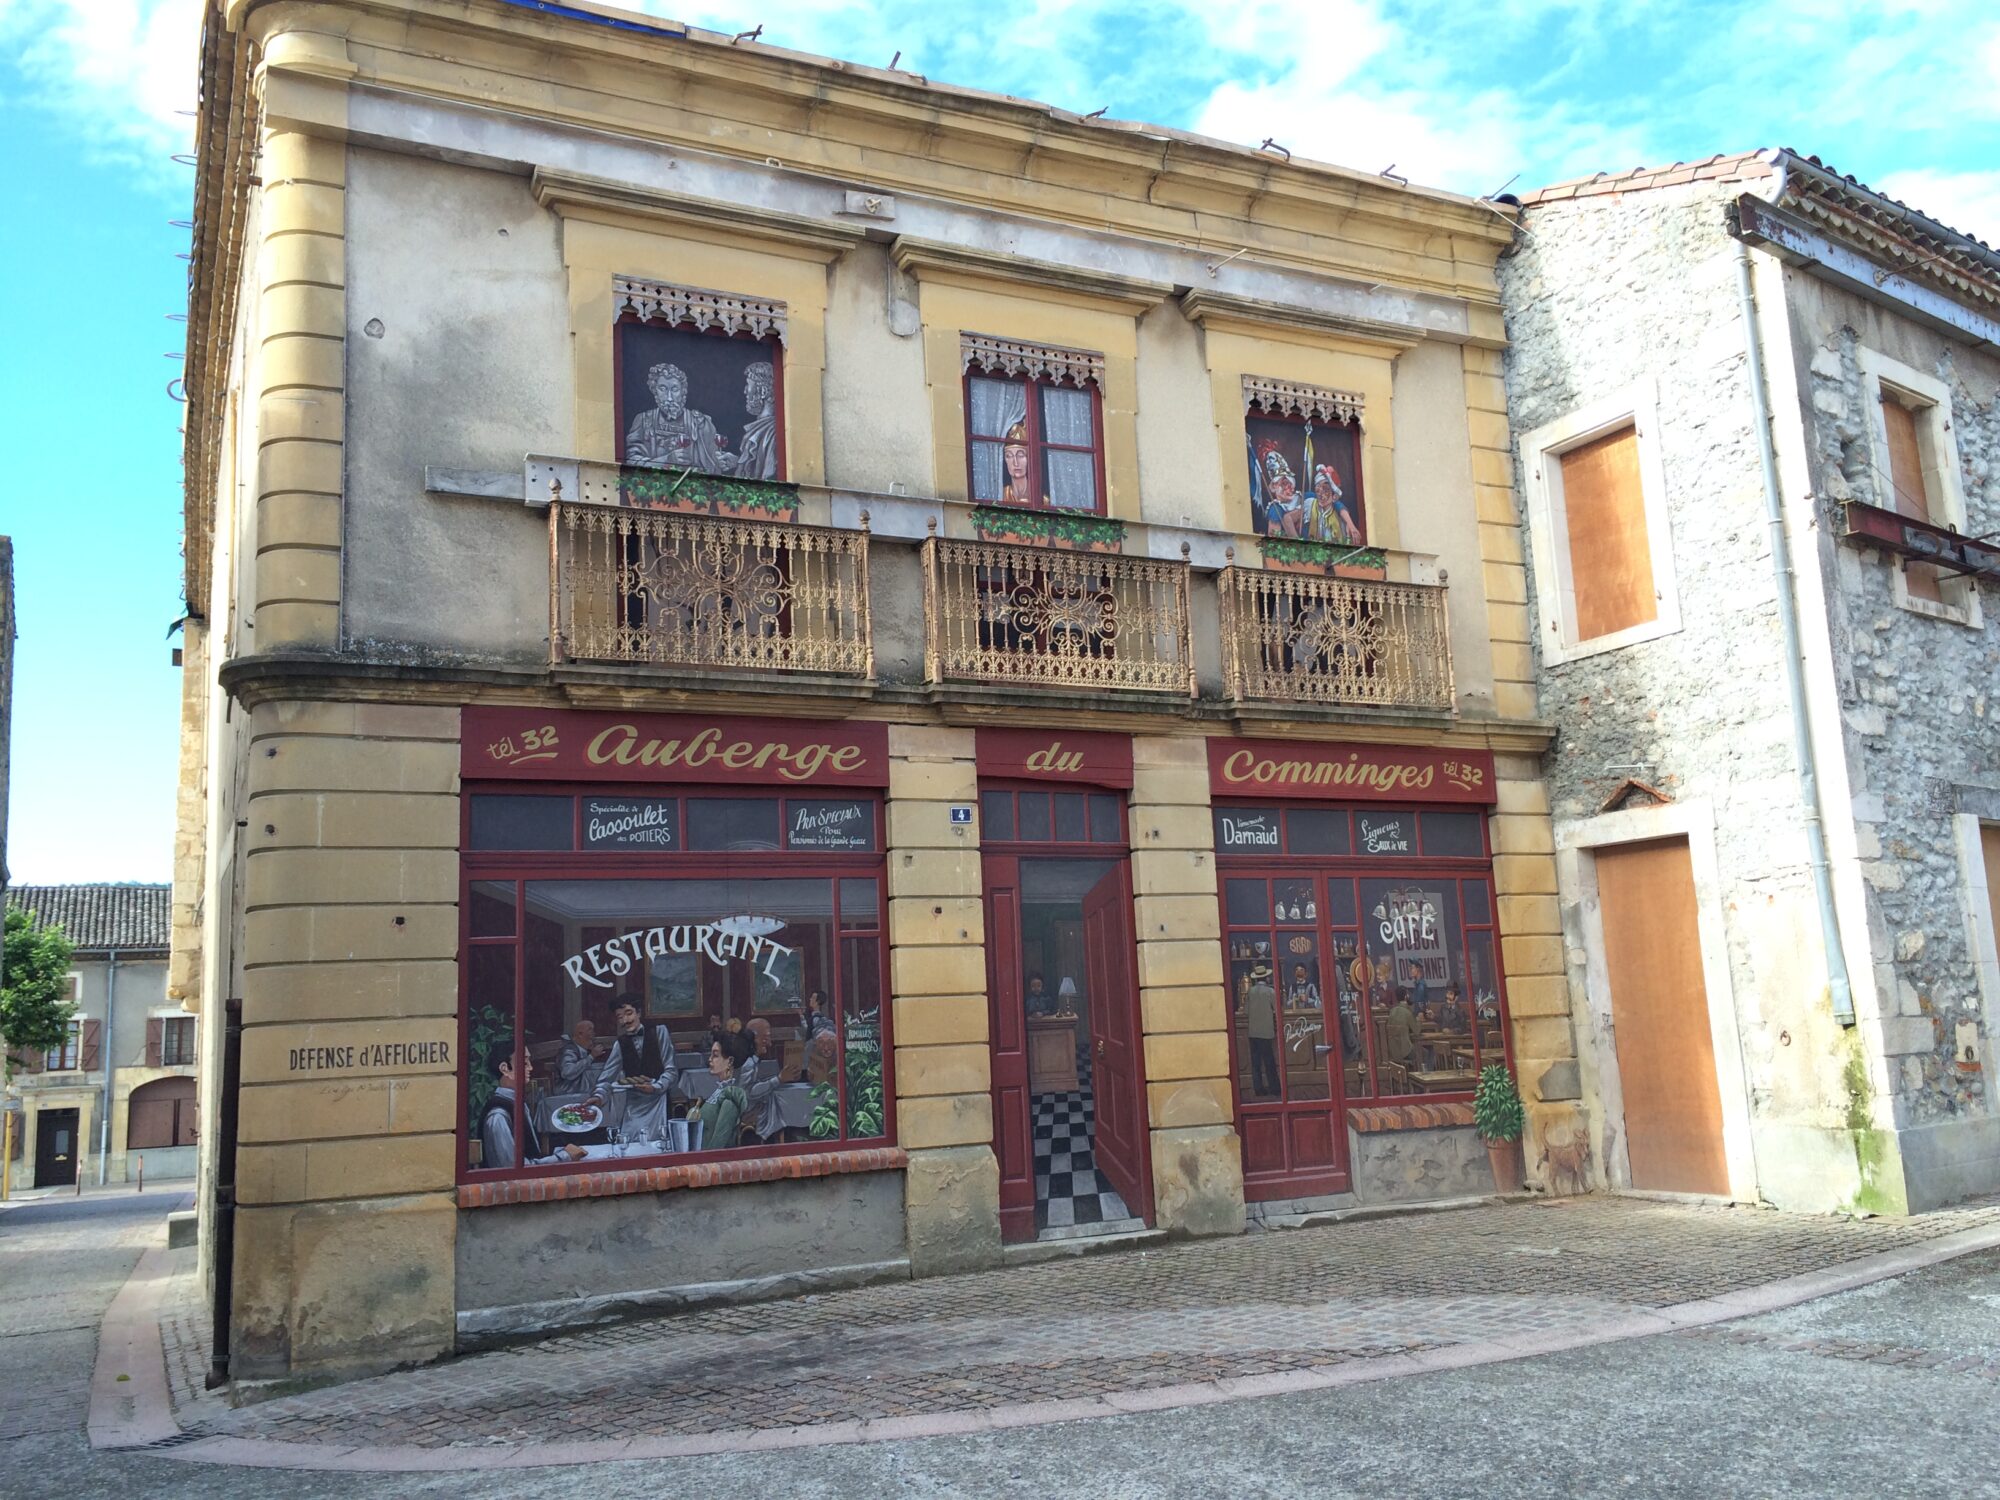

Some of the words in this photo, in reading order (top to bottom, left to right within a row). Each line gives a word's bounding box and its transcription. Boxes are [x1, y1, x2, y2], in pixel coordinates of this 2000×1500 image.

[486, 737, 520, 760] tél
[521, 726, 560, 750] 32
[587, 724, 867, 780] Auberge
[1026, 742, 1084, 772] du
[1223, 750, 1434, 792] Comminges
[1443, 761, 1458, 777] tél
[1461, 764, 1483, 785] 32
[589, 805, 667, 841] Cassoulet
[958, 809, 965, 821] 4
[629, 828, 671, 845] POTIERS
[1222, 818, 1278, 845] Darnaud
[560, 925, 794, 988] RESTAURANT
[290, 1047, 354, 1070] DEFENSE
[360, 1041, 451, 1067] d'AFFICHER
